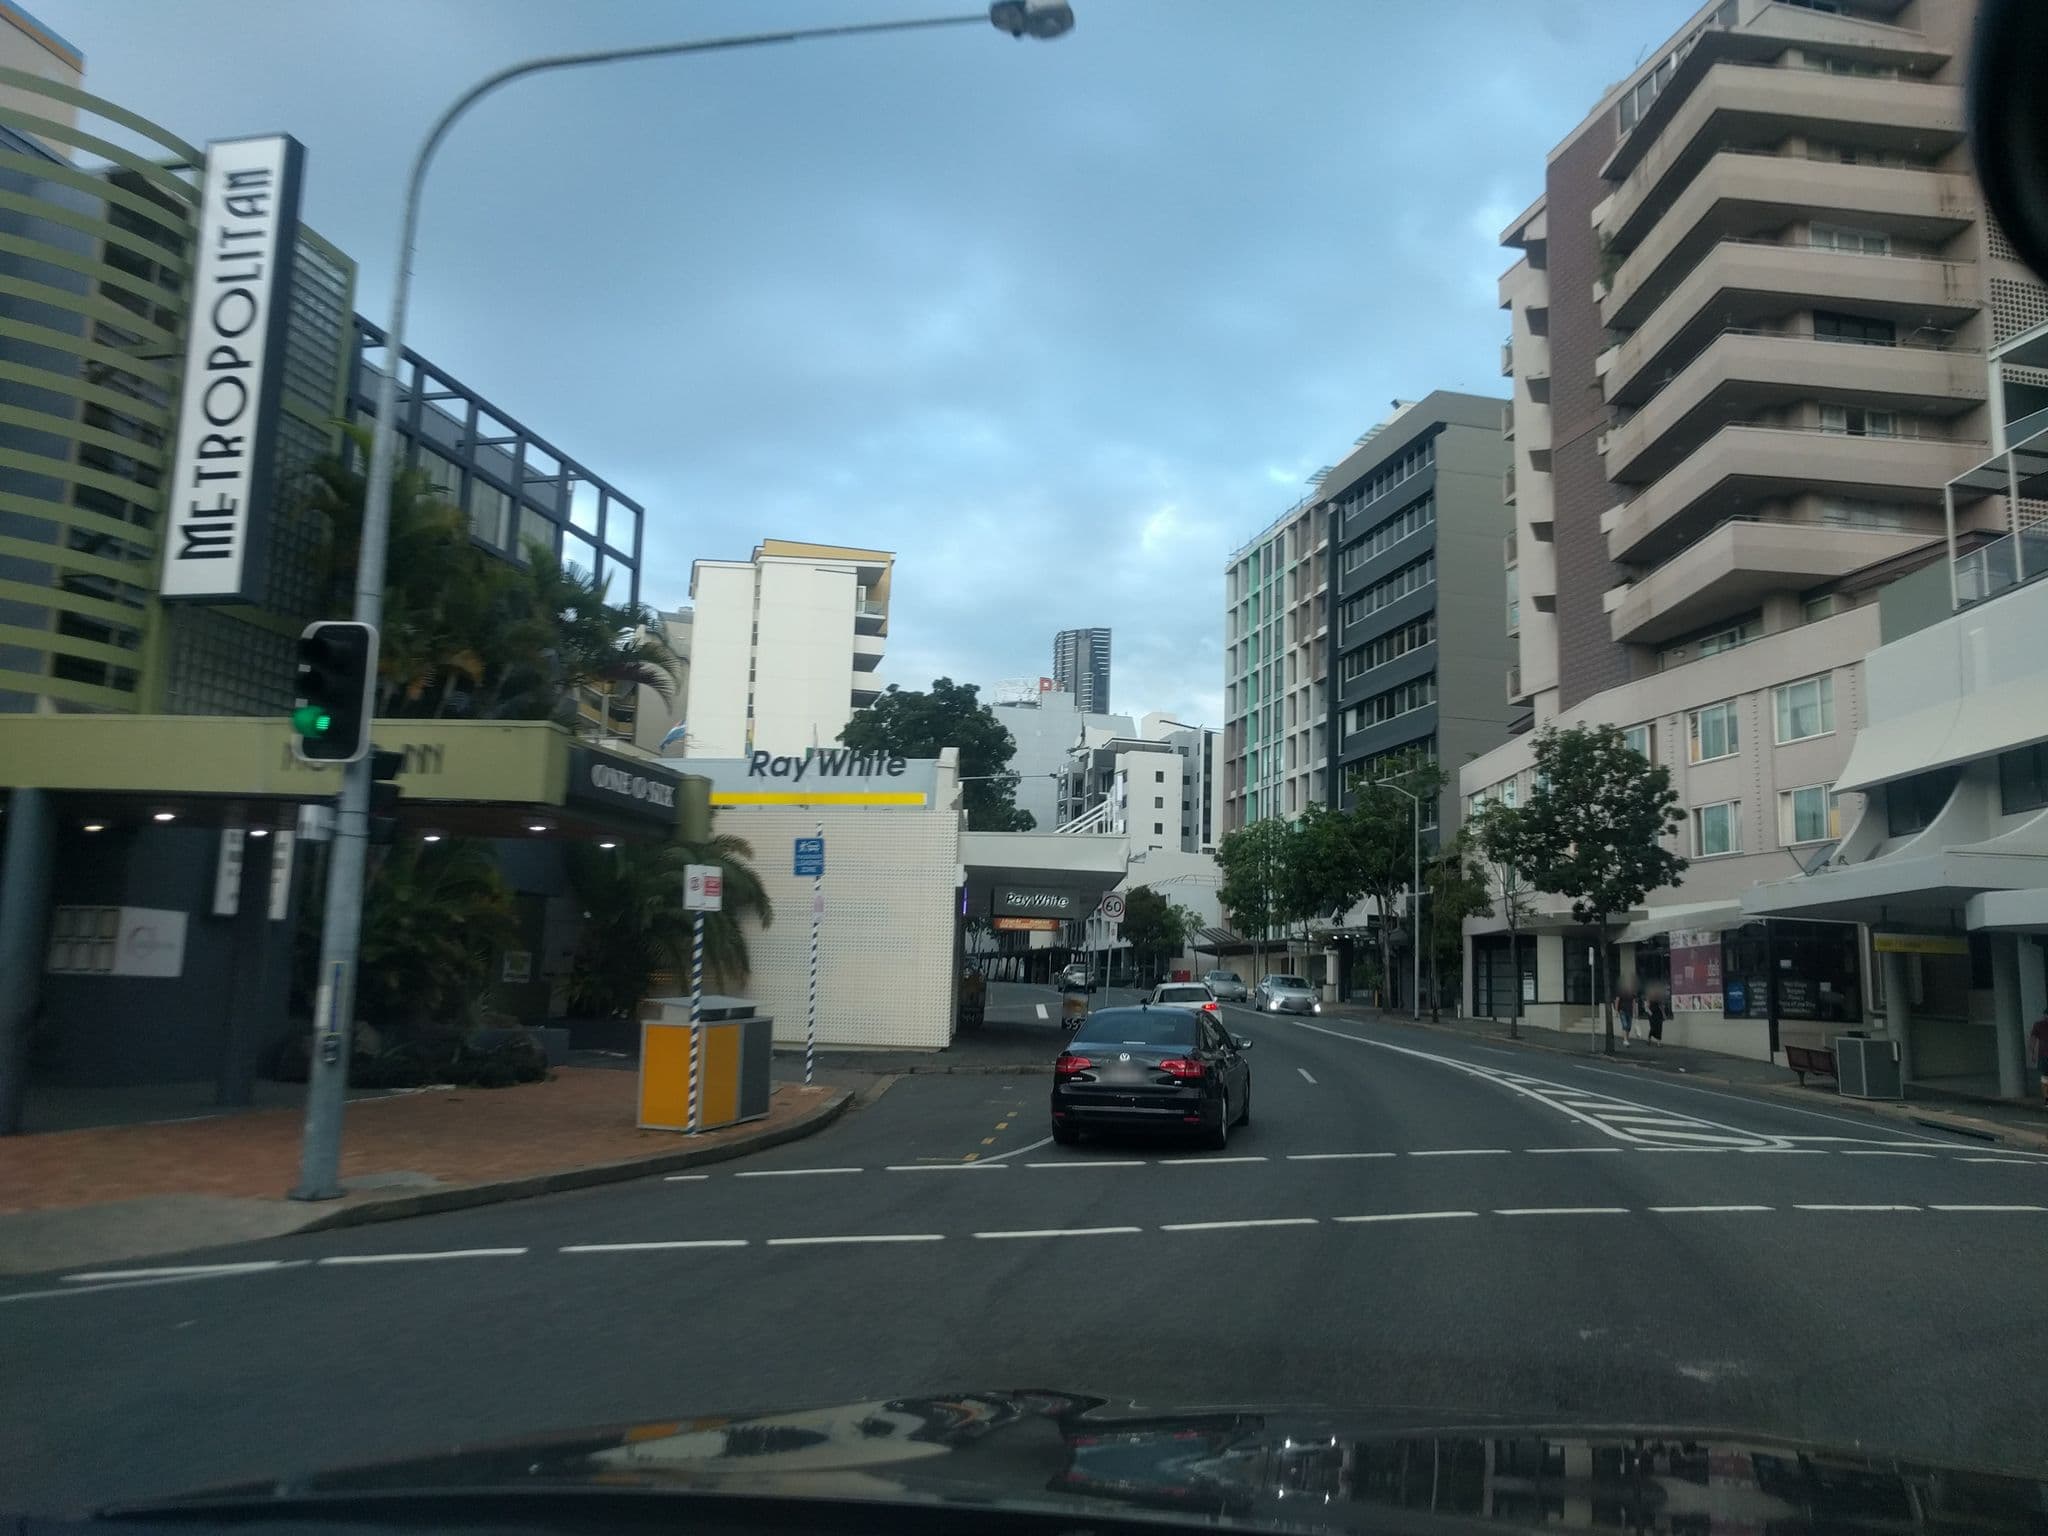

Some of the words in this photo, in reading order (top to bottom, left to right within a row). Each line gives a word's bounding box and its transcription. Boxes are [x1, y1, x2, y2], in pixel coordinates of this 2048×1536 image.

[175, 168, 273, 560] METROPOLITAN
[748, 750, 811, 782] Ray
[817, 748, 907, 776] White
[1006, 892, 1032, 908] Ray
[1033, 894, 1069, 908] White
[1105, 901, 1121, 913] 60
